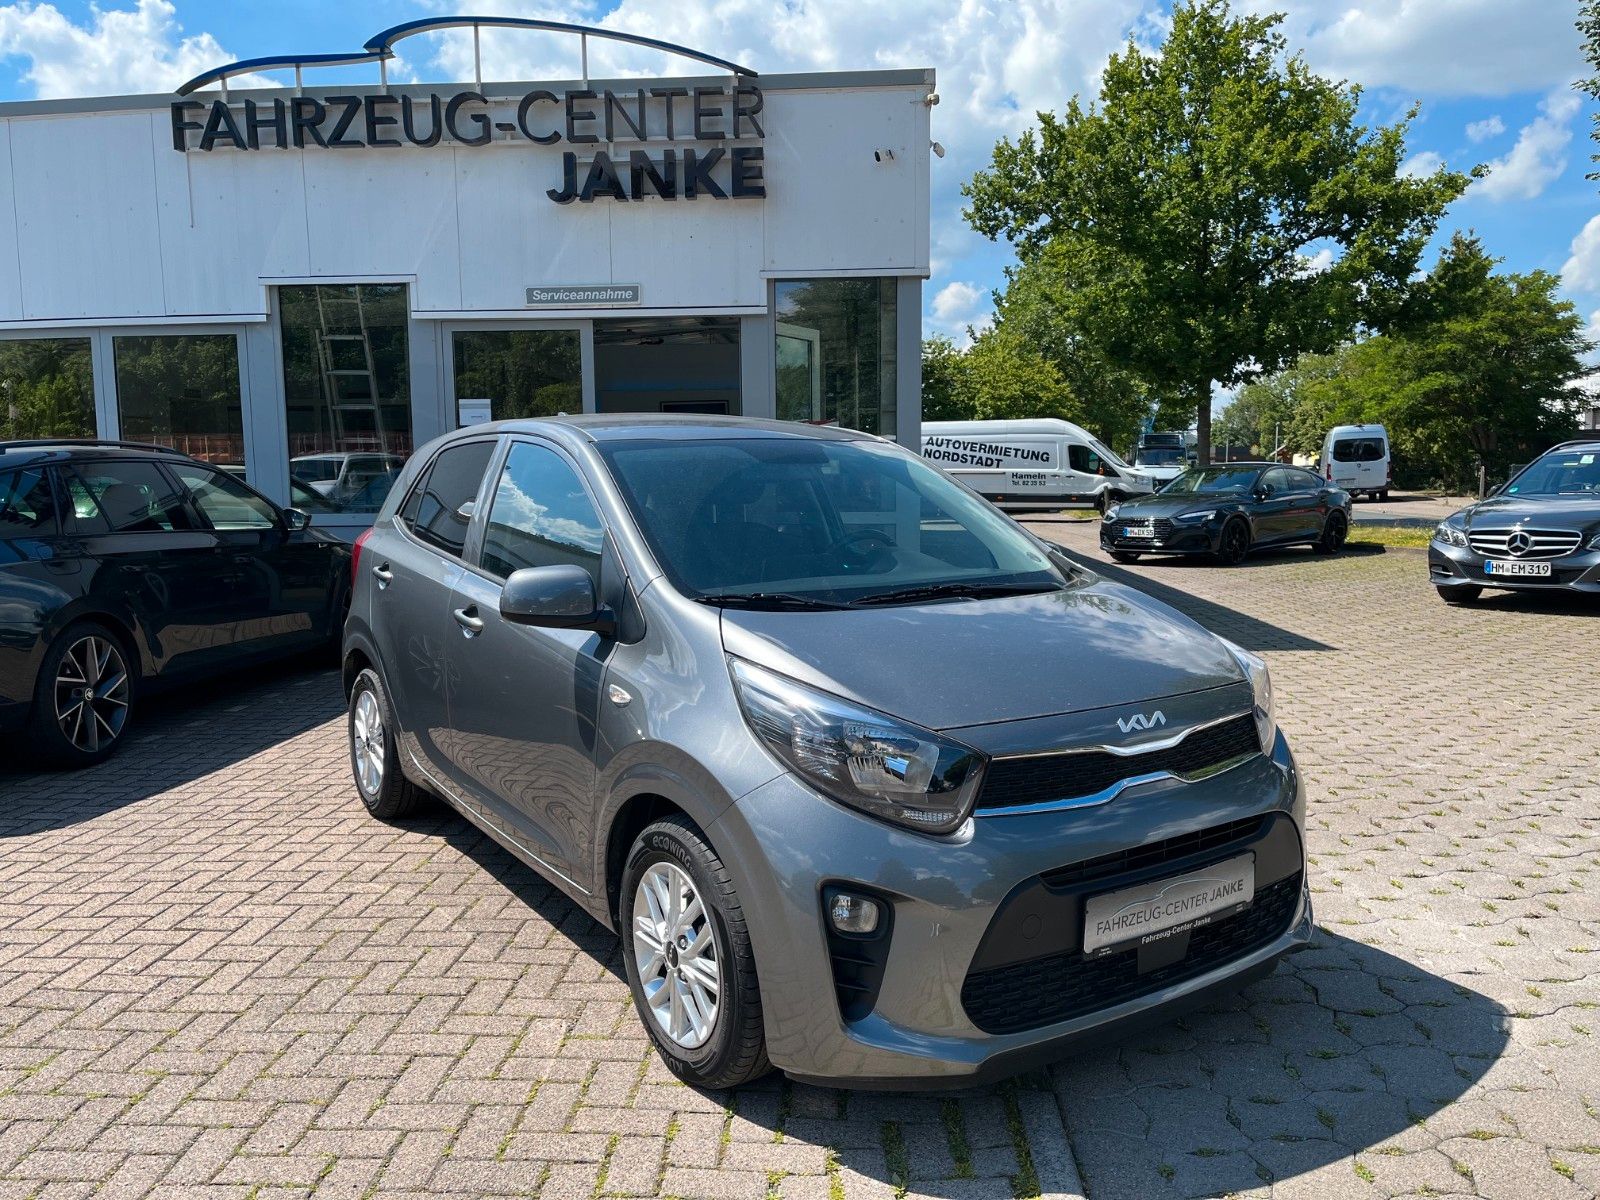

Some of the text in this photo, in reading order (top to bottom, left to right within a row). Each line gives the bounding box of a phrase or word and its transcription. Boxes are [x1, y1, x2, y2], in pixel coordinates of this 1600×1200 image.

[171, 86, 766, 153] FAHRZEUG-CENTER
[546, 147, 766, 205] JANKE
[532, 288, 633, 301] Serviceannahme
[923, 448, 1004, 469] NORDSTADT
[926, 436, 1051, 463] AUTOVERMIETUNG
[1011, 472, 1047, 480] Hameln
[1491, 563, 1549, 575] HM EM 319
[1117, 710, 1167, 733] KIA
[1096, 891, 1208, 936] FAHRZEUG-CENTER
[1209, 879, 1244, 902] JANKE
[1141, 921, 1194, 945] Fahrzeug-Center
[1193, 916, 1212, 928] Janke
